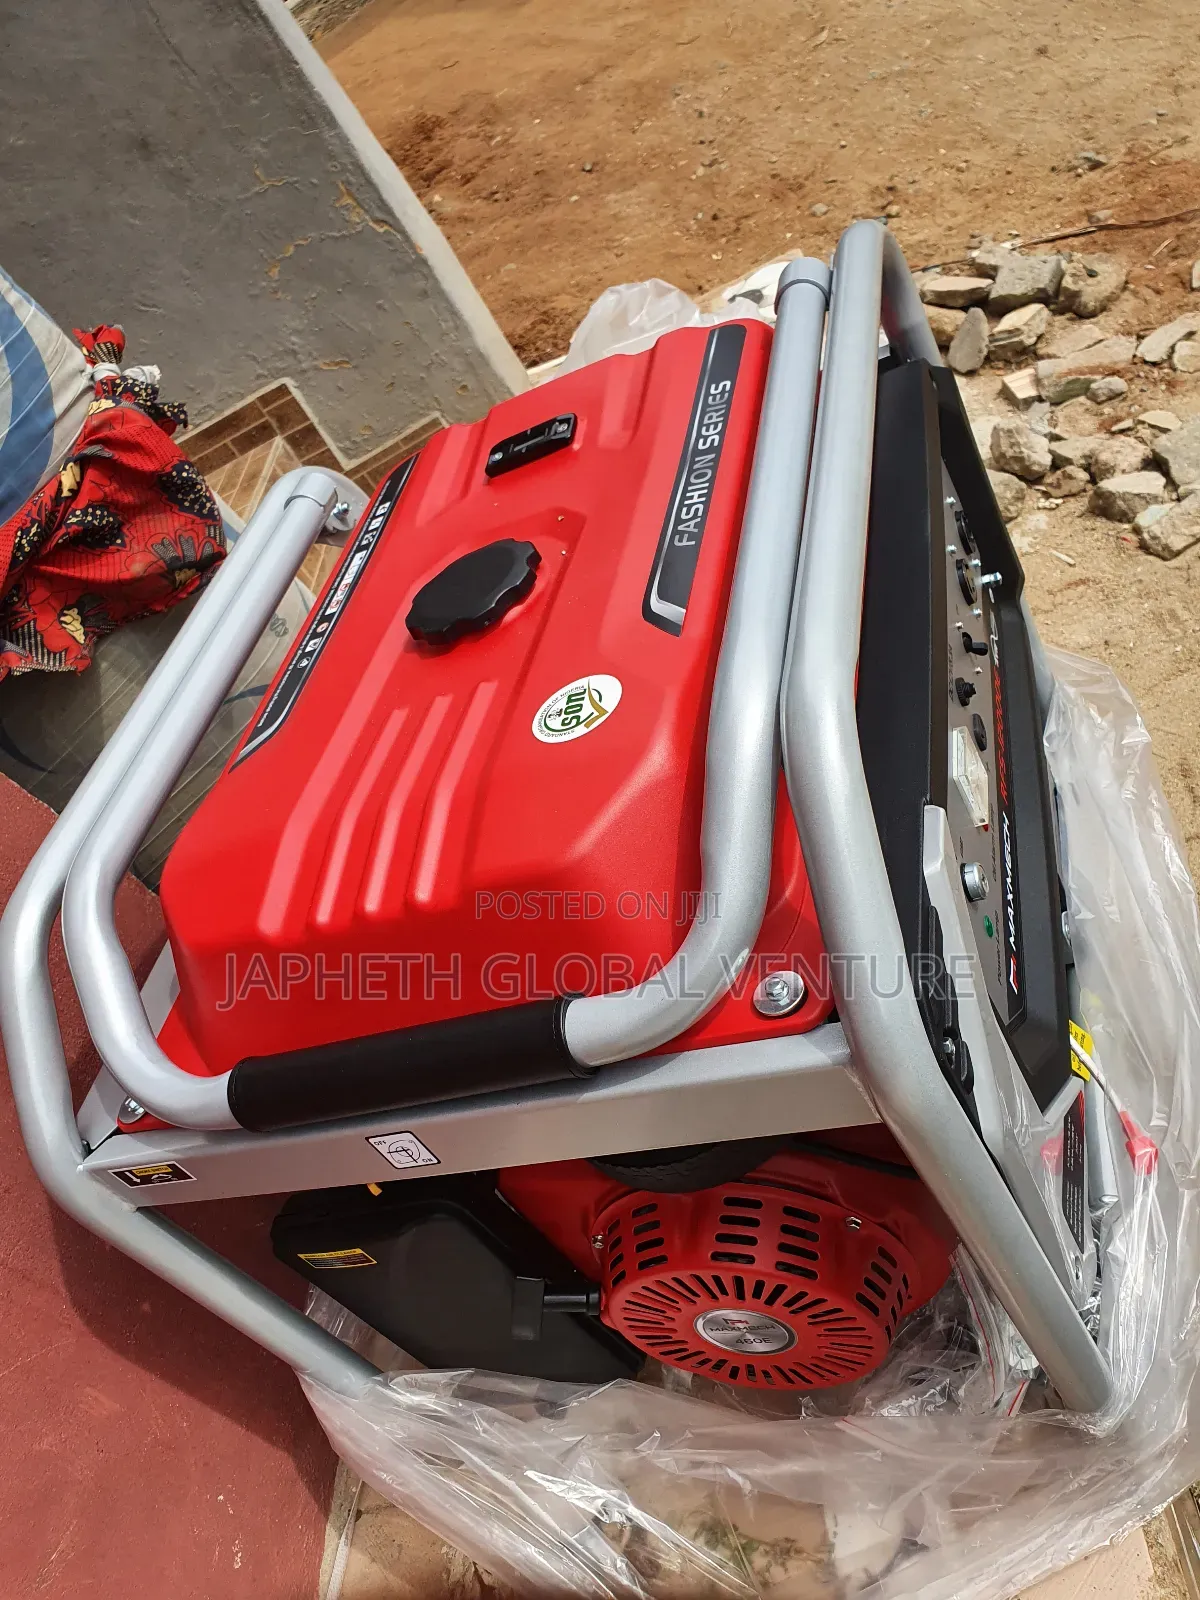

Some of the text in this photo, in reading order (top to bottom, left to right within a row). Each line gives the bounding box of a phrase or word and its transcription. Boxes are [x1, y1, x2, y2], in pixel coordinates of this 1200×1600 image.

[674, 380, 731, 547] FASHION SERIES
[1002, 811, 1017, 952] MAXMECH
[735, 1337, 773, 1345] 460E
